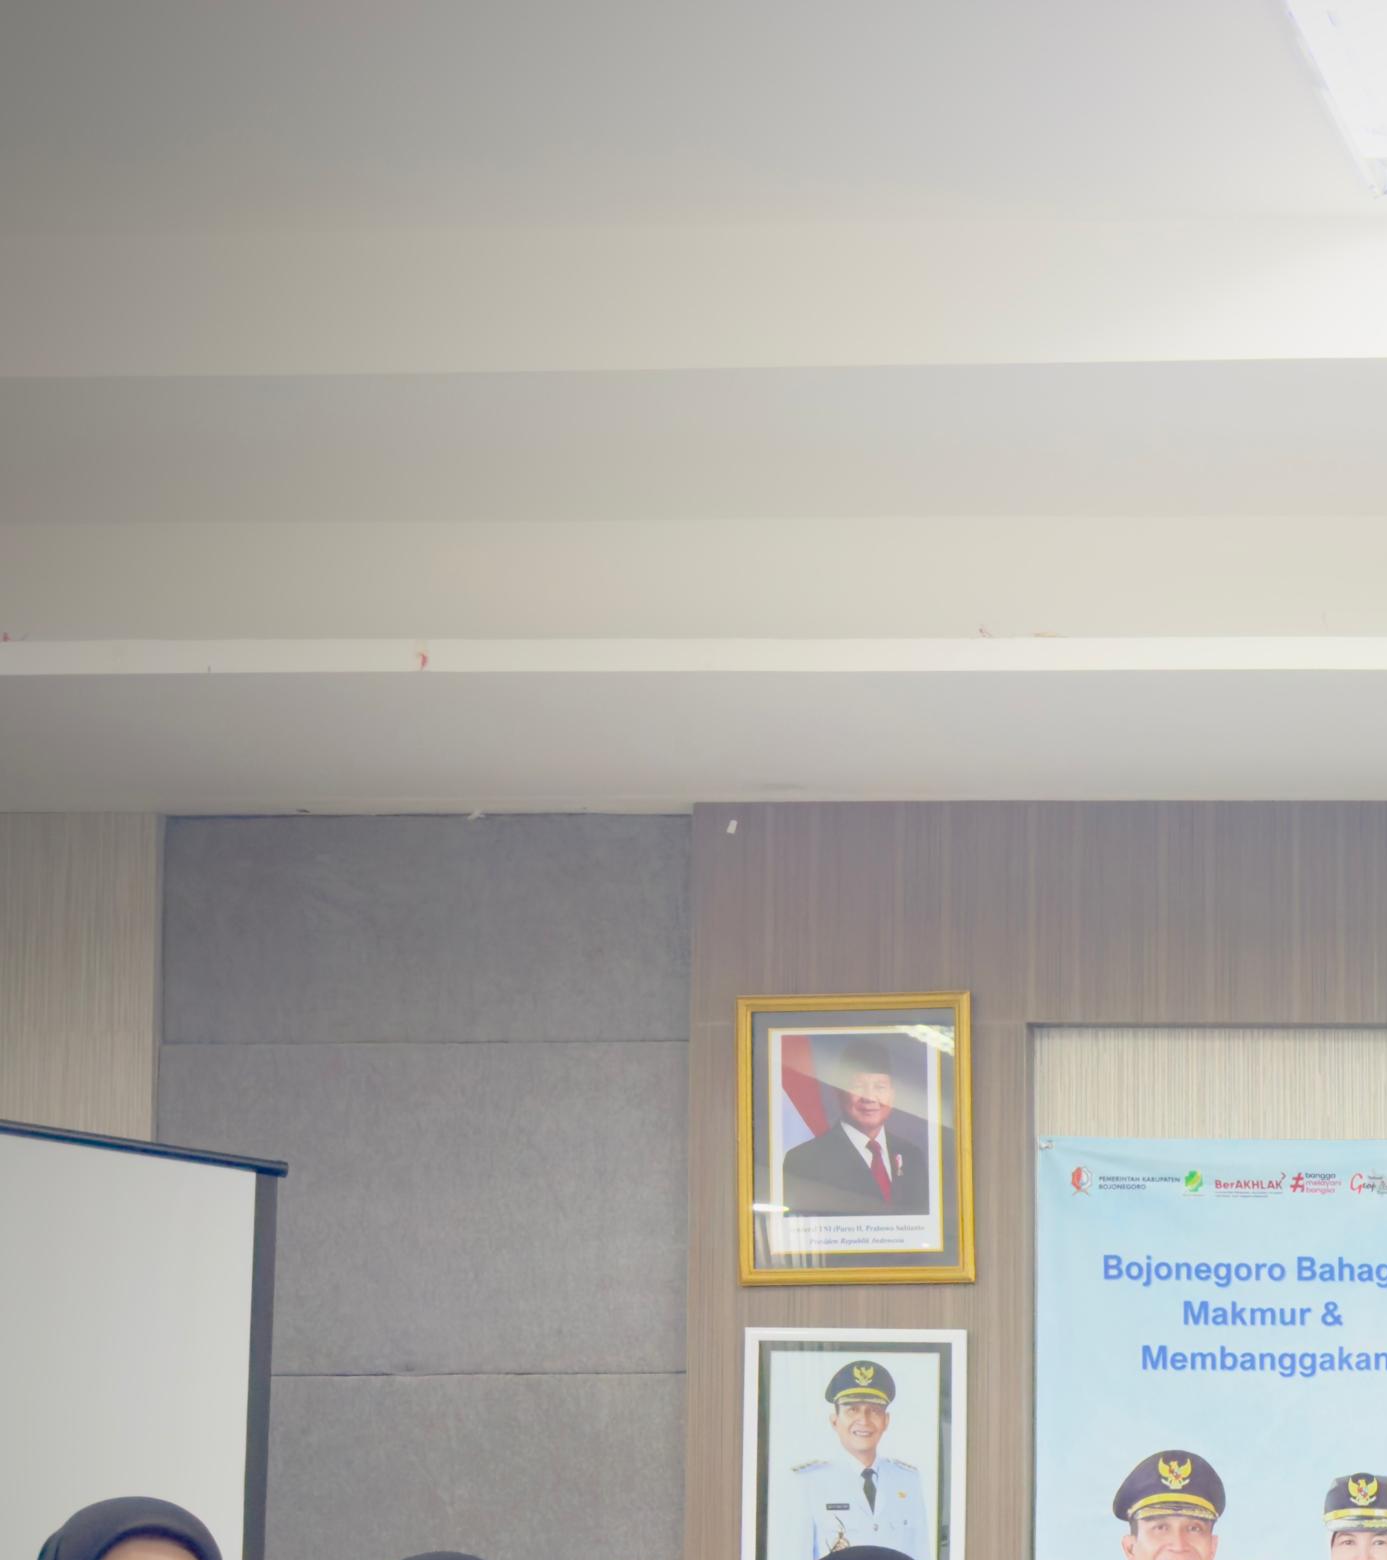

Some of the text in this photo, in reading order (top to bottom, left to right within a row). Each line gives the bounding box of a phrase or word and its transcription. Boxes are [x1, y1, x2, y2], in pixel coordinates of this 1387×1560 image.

[1214, 1179, 1283, 1190] BerAKHLAK
[1103, 1255, 1286, 1287] Bojonegoro
[1183, 1301, 1342, 1326] Makmur &
